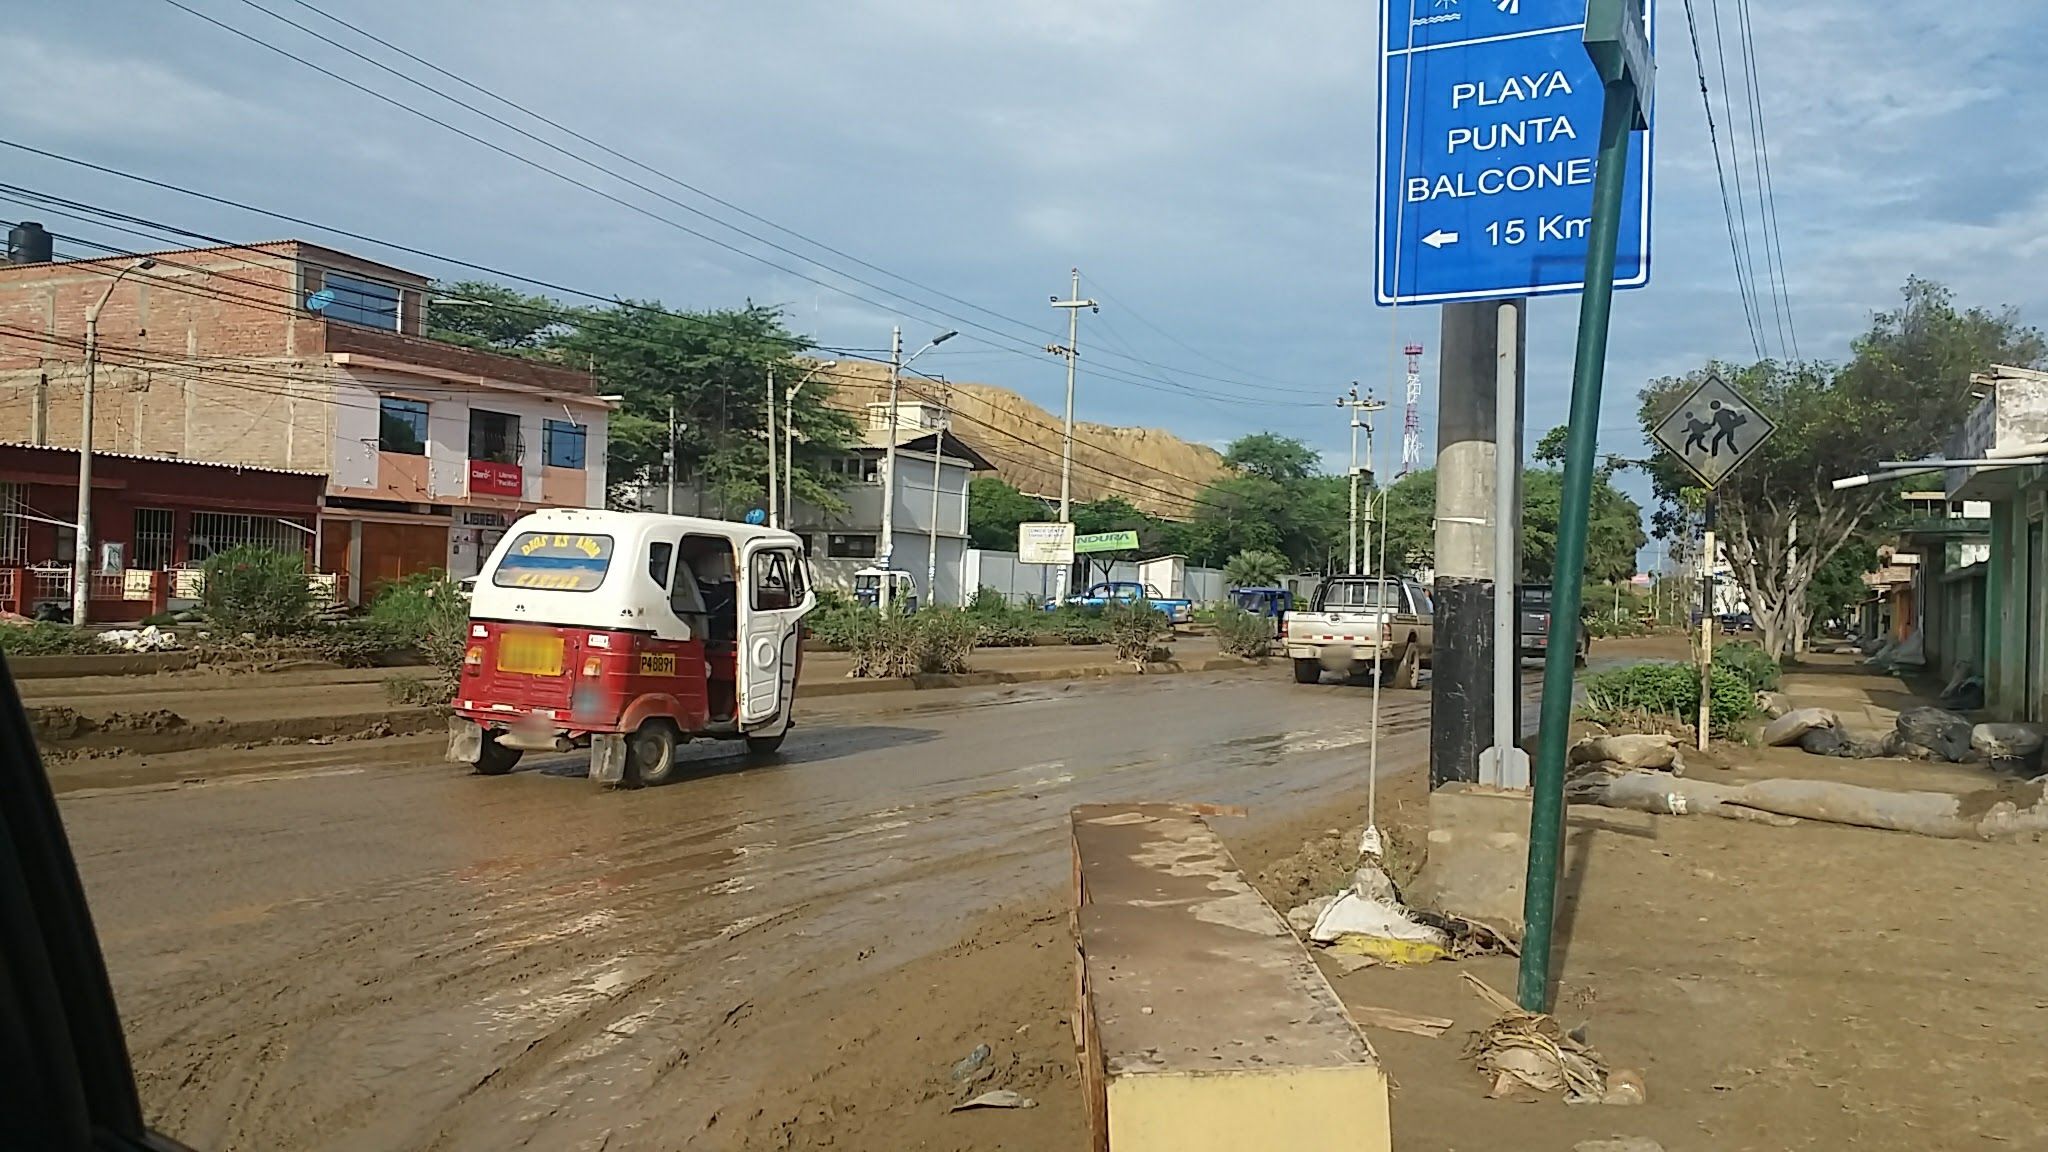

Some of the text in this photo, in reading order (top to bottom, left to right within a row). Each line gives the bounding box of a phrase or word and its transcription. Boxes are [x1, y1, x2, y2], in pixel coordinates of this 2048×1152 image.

[1452, 70, 1572, 109] PLAYA
[1448, 115, 1577, 154] PUNTA
[1486, 219, 1526, 246] 15
[521, 536, 548, 555] DIOS
[553, 535, 569, 547] ES
[1077, 533, 1129, 544] NDURA
